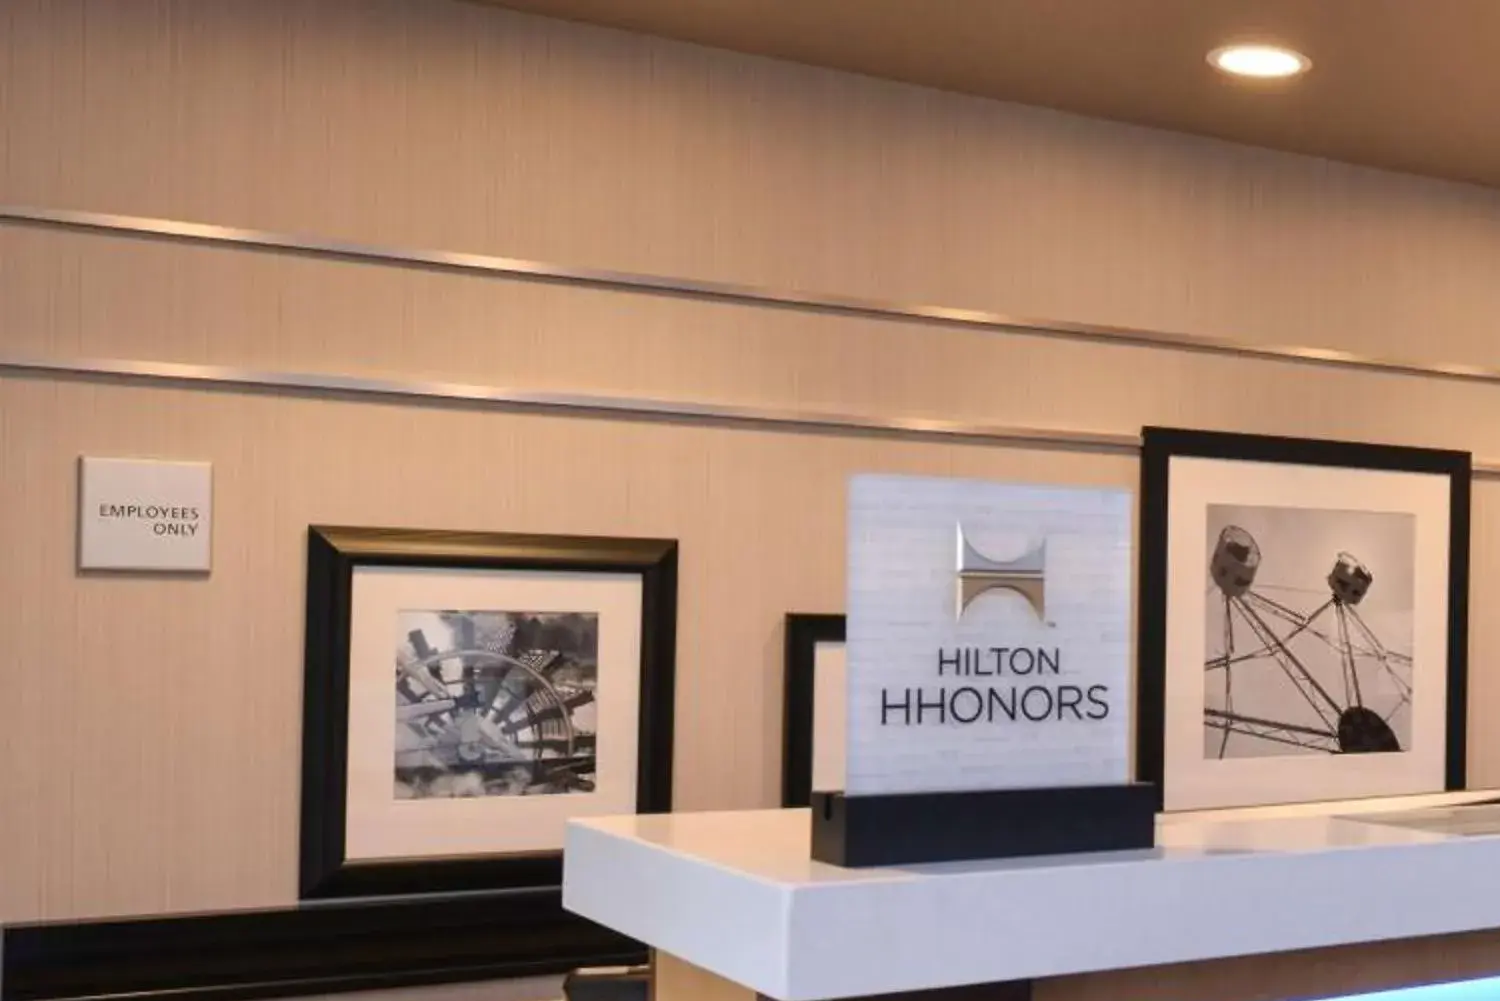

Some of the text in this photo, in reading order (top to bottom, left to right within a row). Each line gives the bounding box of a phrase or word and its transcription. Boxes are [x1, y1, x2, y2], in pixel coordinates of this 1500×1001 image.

[98, 504, 200, 520] EMPLOYEES
[153, 522, 199, 536] ONLY
[937, 647, 1061, 677] HILTON
[880, 684, 1110, 726] HHONORS
